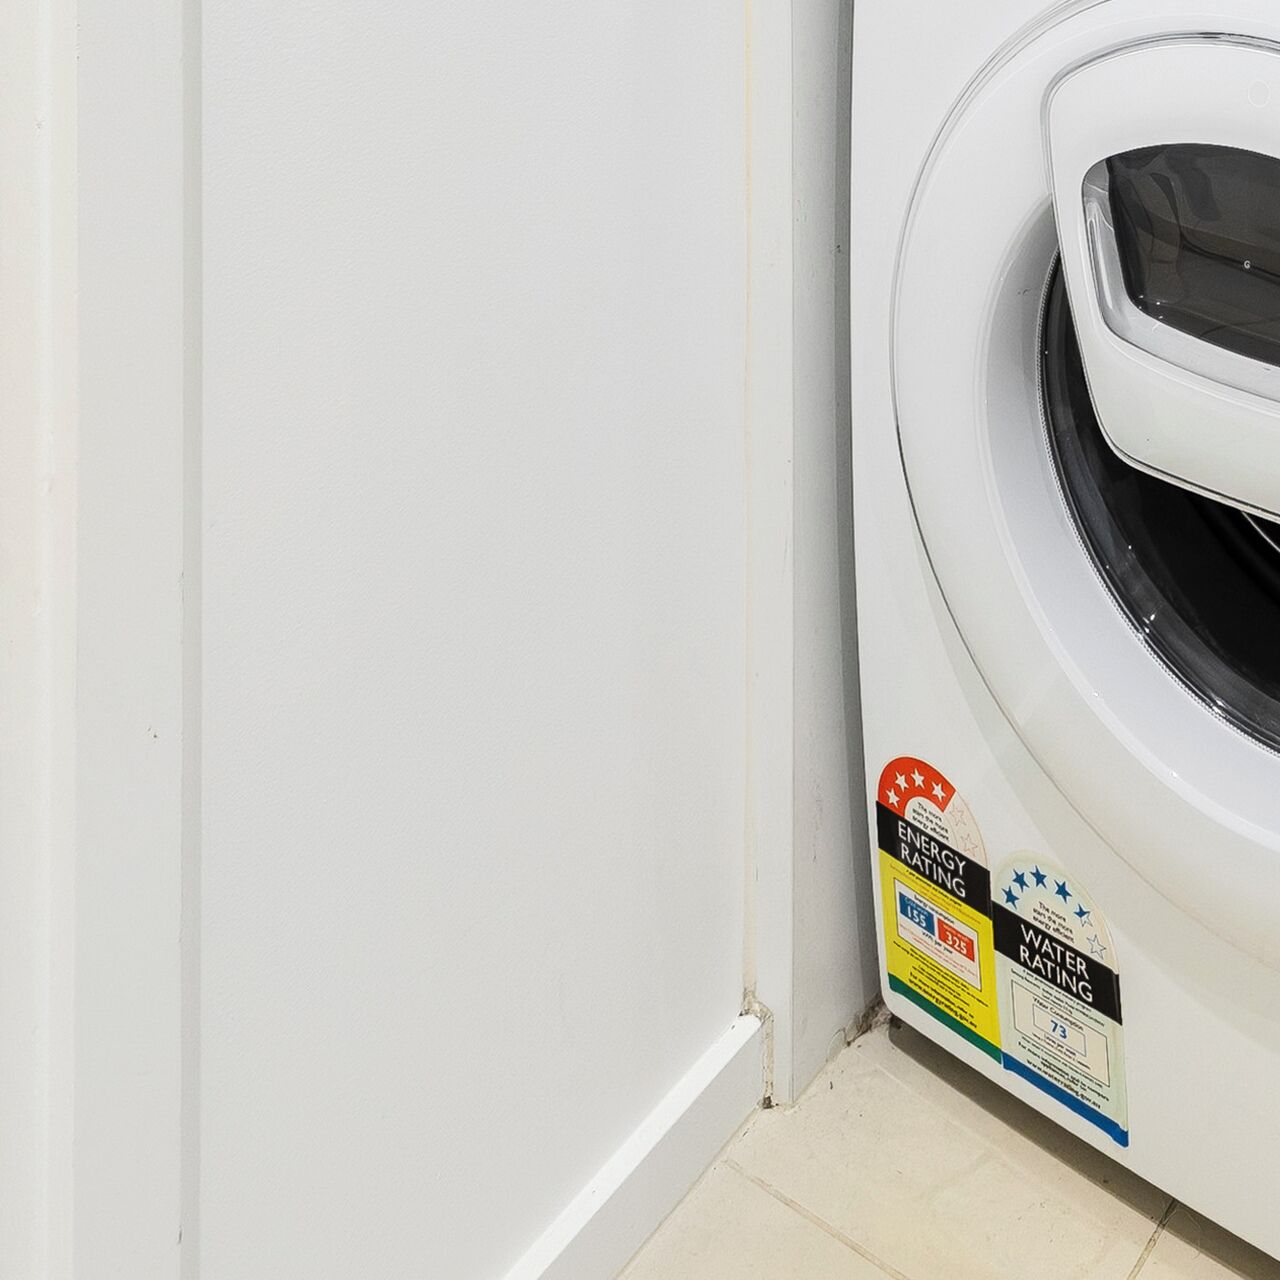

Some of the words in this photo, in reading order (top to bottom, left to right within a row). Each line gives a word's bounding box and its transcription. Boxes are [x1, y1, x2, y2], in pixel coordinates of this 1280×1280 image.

[898, 821, 966, 875] ENERGY
[901, 843, 966, 898] RATING
[907, 905, 926, 927] 155
[945, 931, 967, 954] 325
[1020, 944, 1093, 1003] RATING
[1021, 923, 1089, 980] WATER
[1050, 1019, 1068, 1040] 73
